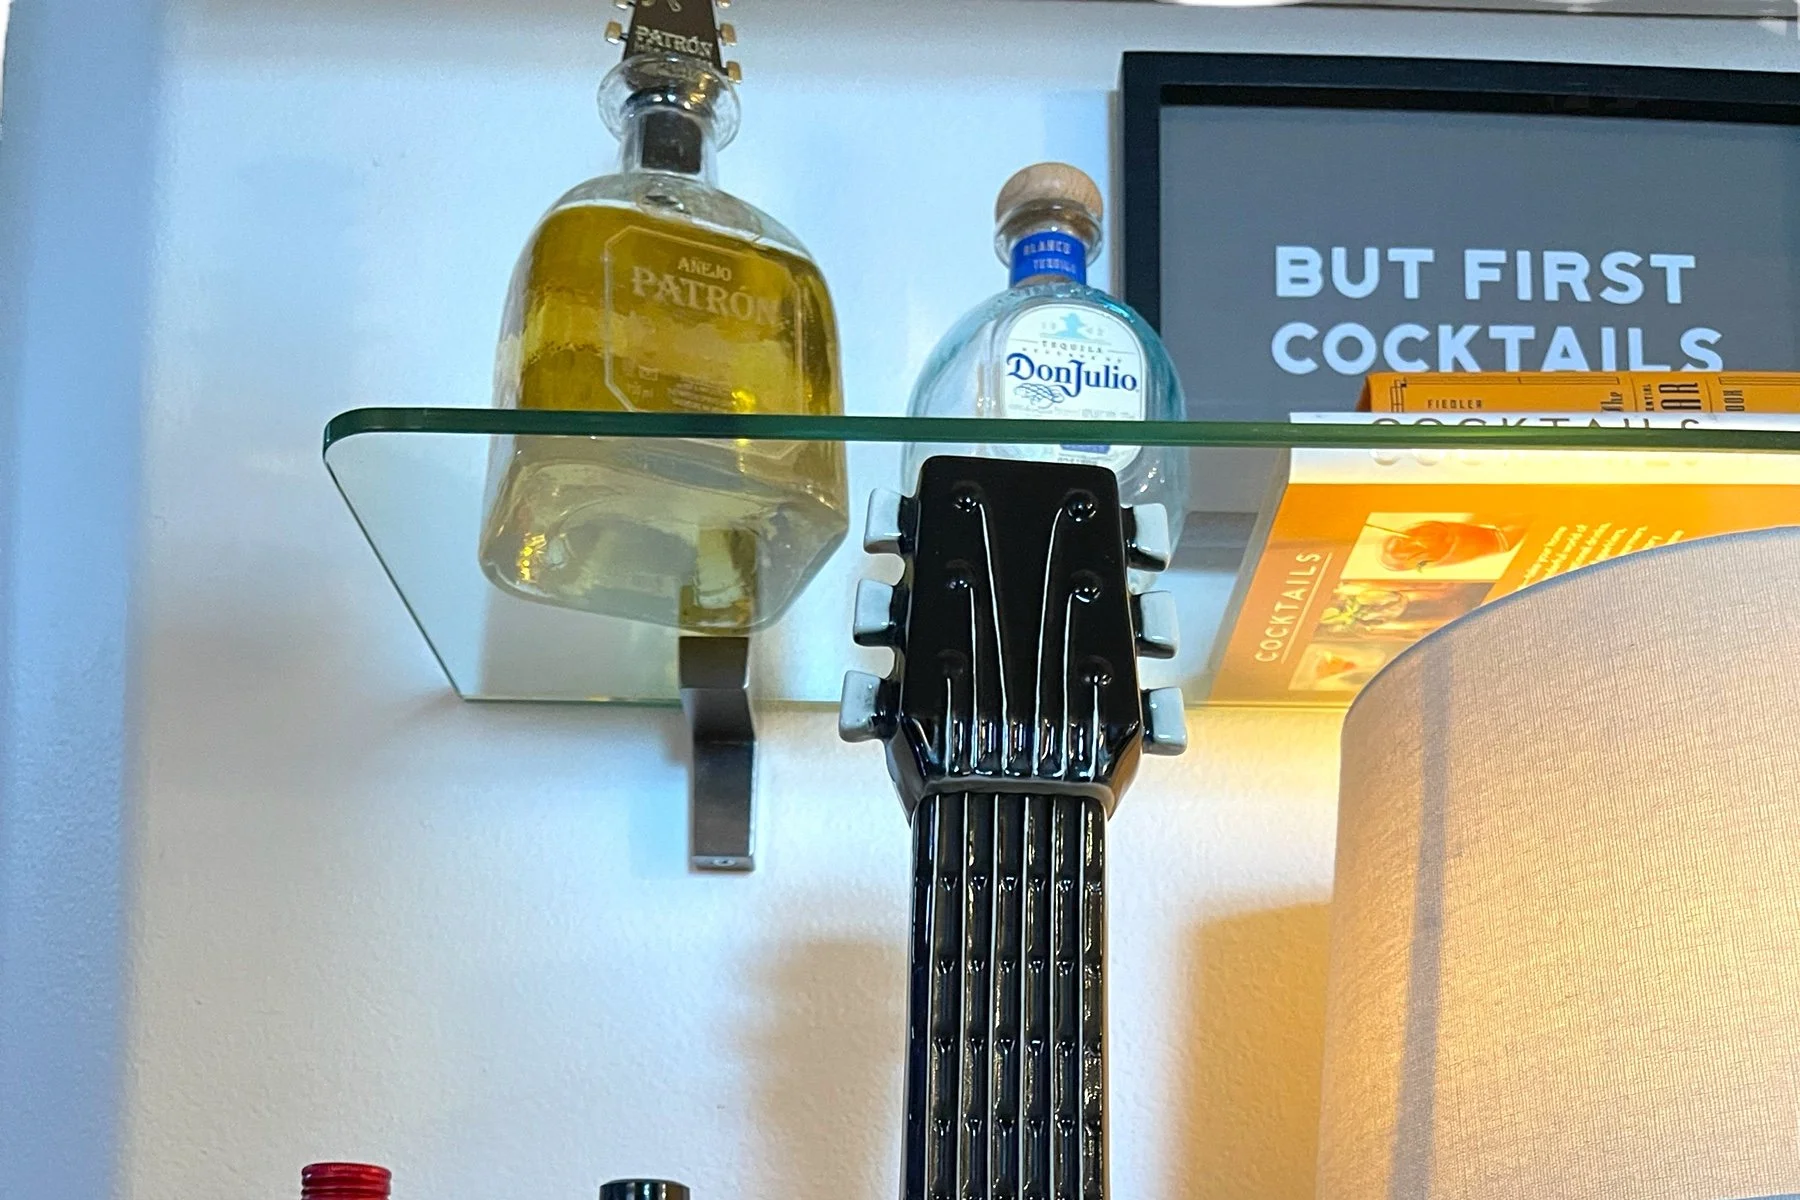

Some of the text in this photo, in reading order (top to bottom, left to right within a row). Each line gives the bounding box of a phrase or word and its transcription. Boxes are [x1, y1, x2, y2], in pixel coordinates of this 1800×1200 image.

[635, 25, 714, 58] PATRÓN
[678, 256, 732, 281] AÑEJO
[1275, 245, 1696, 304] BUT FIRST
[632, 265, 784, 326] PATRÓN
[1042, 340, 1102, 354] TEQUILA
[1271, 322, 1724, 376] COCKTAILS
[1427, 399, 1482, 409] FIEDLER
[1658, 383, 1702, 411] AR
[1723, 390, 1745, 411] OOK
[1254, 553, 1322, 662] COCKTAILS
